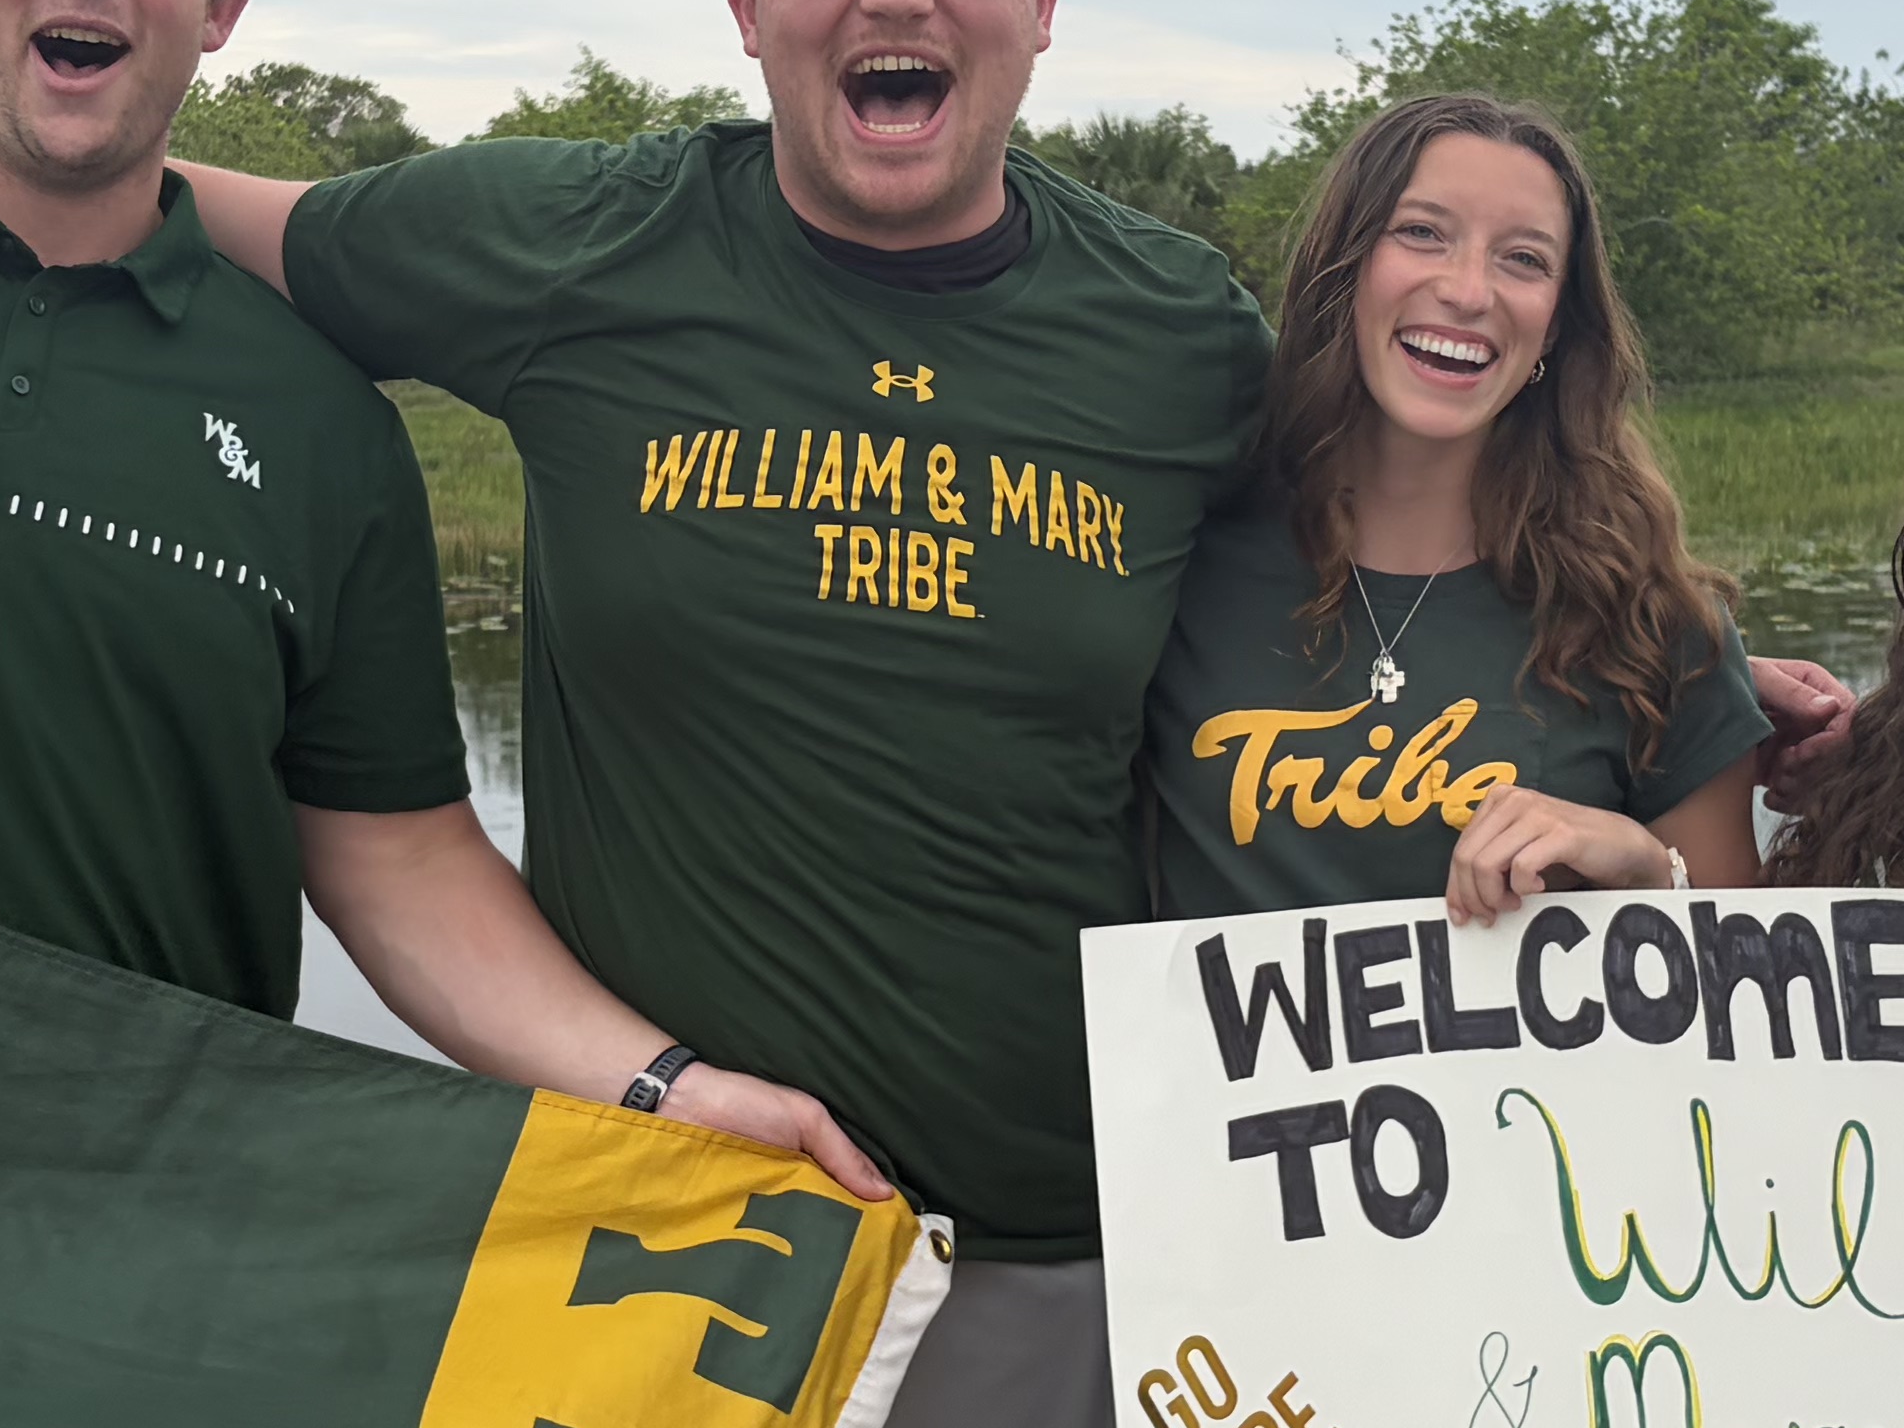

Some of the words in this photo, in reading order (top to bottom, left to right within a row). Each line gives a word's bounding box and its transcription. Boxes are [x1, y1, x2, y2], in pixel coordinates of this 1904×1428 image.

[202, 411, 262, 490] W&M
[639, 428, 907, 516] WILLIAM
[926, 442, 968, 525] &
[989, 454, 1128, 577] MARY
[813, 523, 978, 619] TRIBE
[1191, 697, 1518, 846] Tribe
[1226, 1083, 1451, 1243] TO
